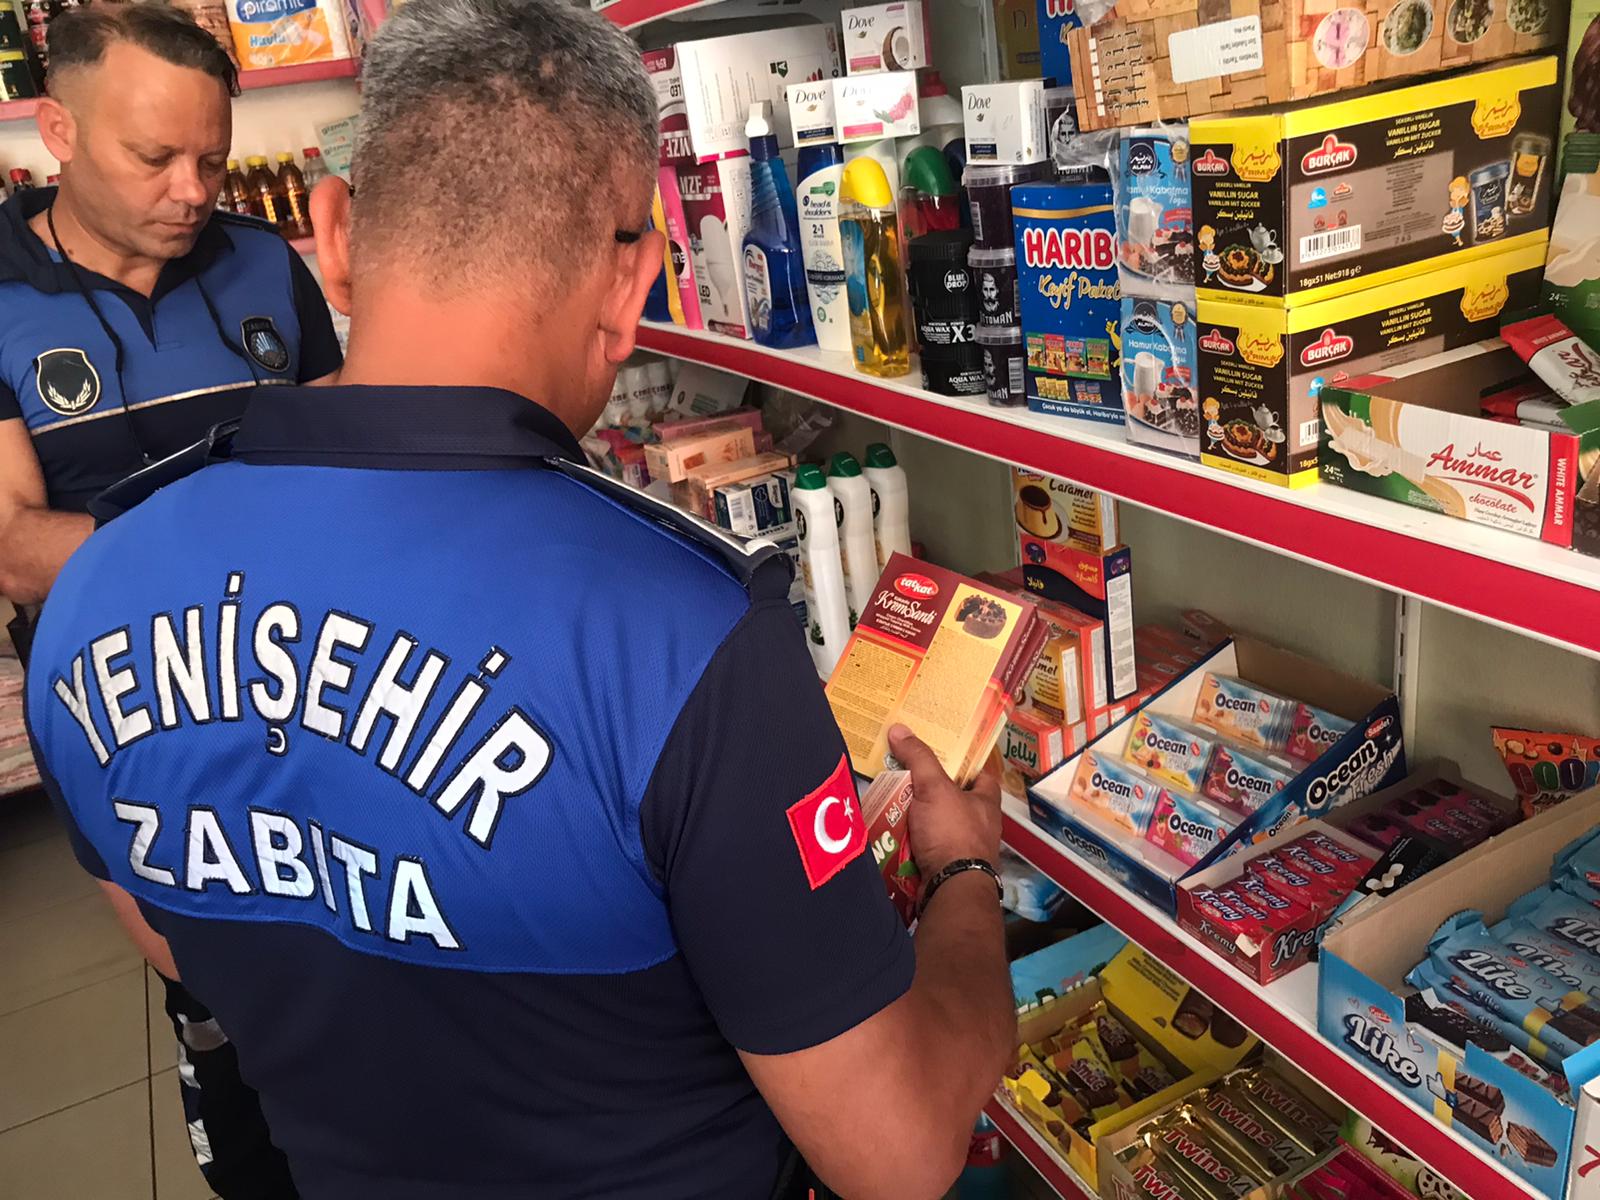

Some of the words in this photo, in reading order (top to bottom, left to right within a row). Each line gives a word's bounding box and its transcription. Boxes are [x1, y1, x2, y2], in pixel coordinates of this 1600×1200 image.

[848, 15, 875, 30] Dove
[669, 84, 682, 97] LED
[795, 89, 826, 104] Dove
[967, 92, 992, 110] Dove
[1418, 119, 1441, 130] SUGAR
[1196, 162, 1225, 172] BURÇAK
[1308, 149, 1350, 169] BURÇAK
[1237, 191, 1259, 199] SUGAR
[1024, 228, 1119, 270] HARIB
[1411, 308, 1431, 320] SUGAR
[1202, 341, 1230, 352] BURÇAK
[1307, 341, 1347, 360] BURÇAK
[949, 376, 968, 385] AQUA
[1242, 372, 1263, 382] SUGAR
[1324, 464, 1335, 474] 24
[1426, 443, 1535, 489] Ammar
[1556, 458, 1567, 487] WHITE
[1049, 479, 1094, 499] Caramel
[1468, 493, 1518, 514] chocolate
[1554, 489, 1566, 526] AMMAR
[53, 571, 555, 851] YENİŞEHİR
[1215, 693, 1256, 713] Ocean
[1147, 732, 1187, 755] Ocean
[1092, 772, 1130, 798] Ocean
[1227, 769, 1272, 794] Ocean
[1308, 741, 1376, 807] Ocean
[1351, 751, 1394, 799] Fresh
[1170, 814, 1213, 841] Ocean
[1268, 811, 1291, 837] Ocean
[1063, 827, 1106, 862] Ocean
[1306, 834, 1359, 862] Kremy
[1256, 857, 1311, 886] Kremy
[1281, 846, 1336, 874] Kremy
[113, 798, 465, 950] ZABITA
[1193, 889, 1245, 921] Kremy
[1238, 879, 1290, 909] Kremy
[1200, 919, 1237, 954] Kremy
[1270, 925, 1318, 967] Kre
[1456, 951, 1531, 999] Like
[1347, 1015, 1420, 1085] Like
[1252, 1080, 1321, 1132] Twins
[1207, 1094, 1274, 1148] Twins
[1164, 1128, 1234, 1182] Twins
[1134, 1164, 1184, 1200] Twi
